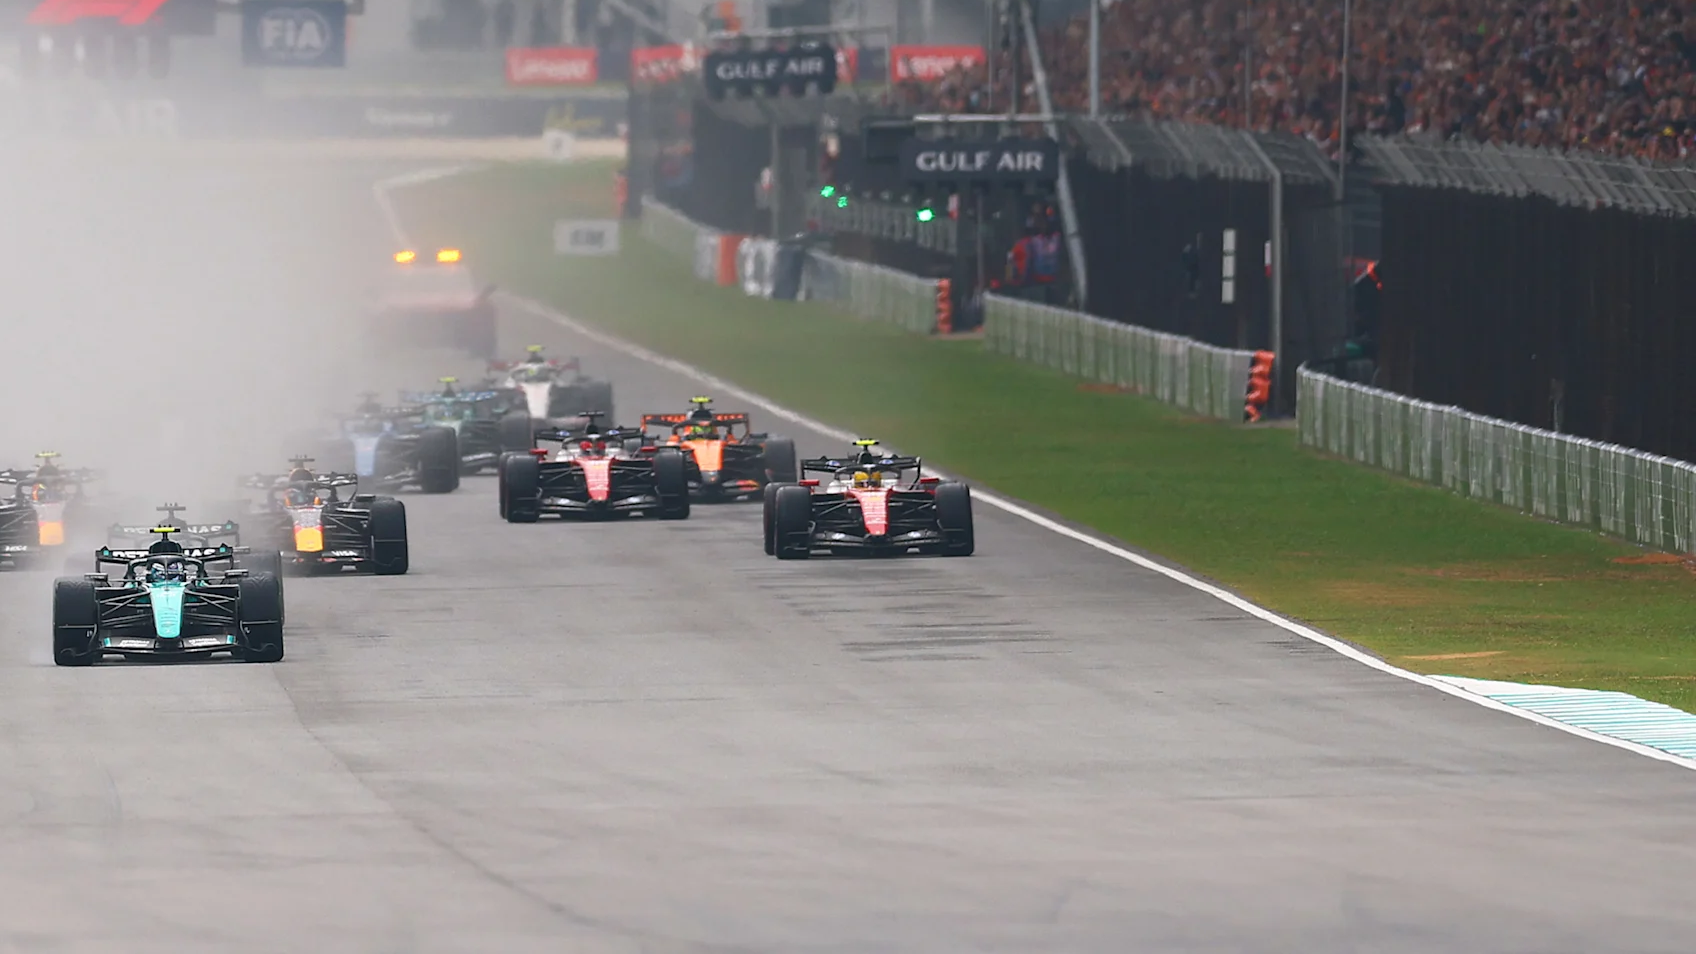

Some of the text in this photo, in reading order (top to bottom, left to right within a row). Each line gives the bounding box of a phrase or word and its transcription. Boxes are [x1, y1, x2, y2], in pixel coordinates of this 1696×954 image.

[716, 59, 778, 80] GULF
[784, 56, 824, 76] AIR
[915, 151, 1044, 172] GULF AIR
